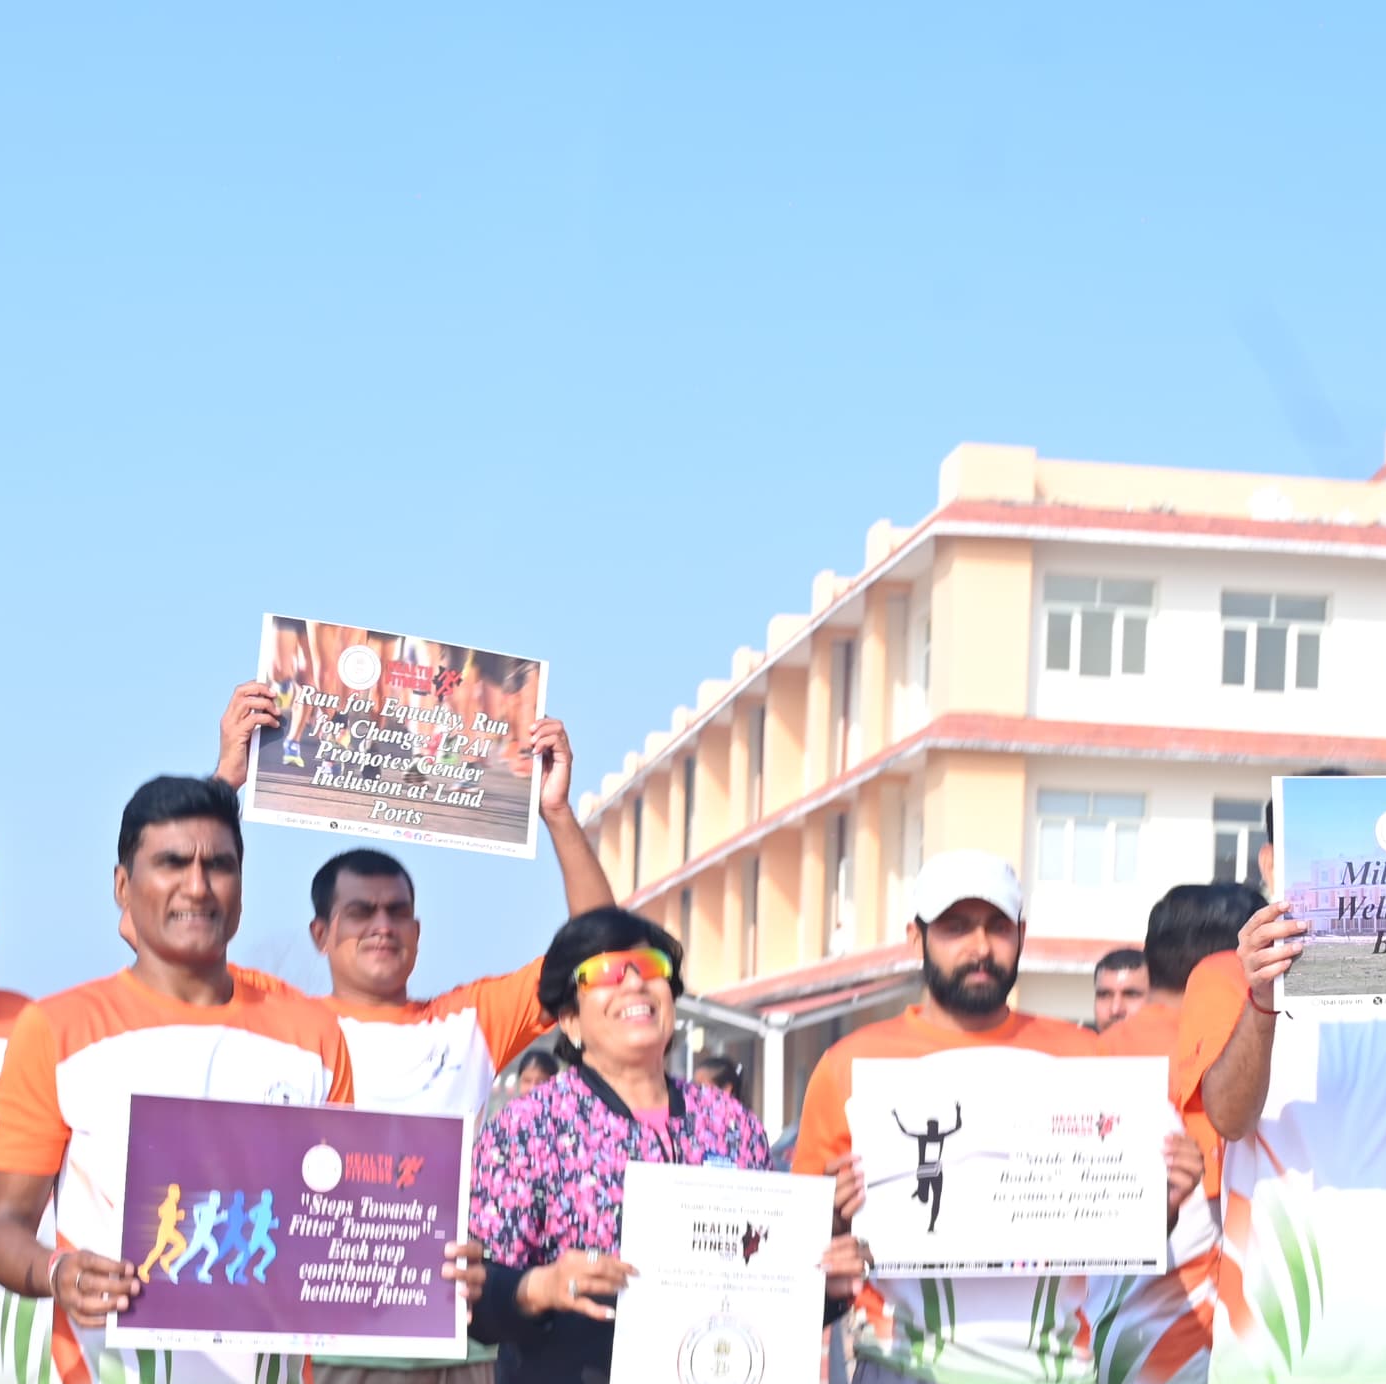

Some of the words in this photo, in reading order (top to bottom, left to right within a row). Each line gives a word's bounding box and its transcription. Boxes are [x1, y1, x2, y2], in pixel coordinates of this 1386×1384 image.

[297, 684, 340, 709] Run
[342, 692, 376, 717] for
[380, 698, 464, 730] Equality,
[470, 712, 510, 736] Run
[309, 713, 346, 738] for
[351, 719, 431, 751] Change:
[437, 732, 492, 758] LPAI
[315, 740, 411, 776] Promotes
[416, 755, 484, 783] Gender
[311, 766, 403, 797] Inclusion
[406, 780, 429, 800] at
[432, 783, 485, 809] Land
[369, 800, 424, 825] Ports
[346, 1152, 393, 1169] HEALTH
[301, 1192, 353, 1219] "Steps
[360, 1196, 424, 1221] Towards
[427, 1203, 438, 1221] a
[289, 1214, 334, 1238] Fitter
[341, 1219, 431, 1242] Tomorrow"
[693, 1220, 739, 1235] HEALTH
[328, 1238, 370, 1261] Each
[373, 1243, 406, 1265] step
[692, 1239, 737, 1253] FITNESS
[298, 1260, 397, 1286] contributing
[401, 1264, 418, 1283] to
[421, 1266, 432, 1284] a
[300, 1279, 371, 1303] healthier
